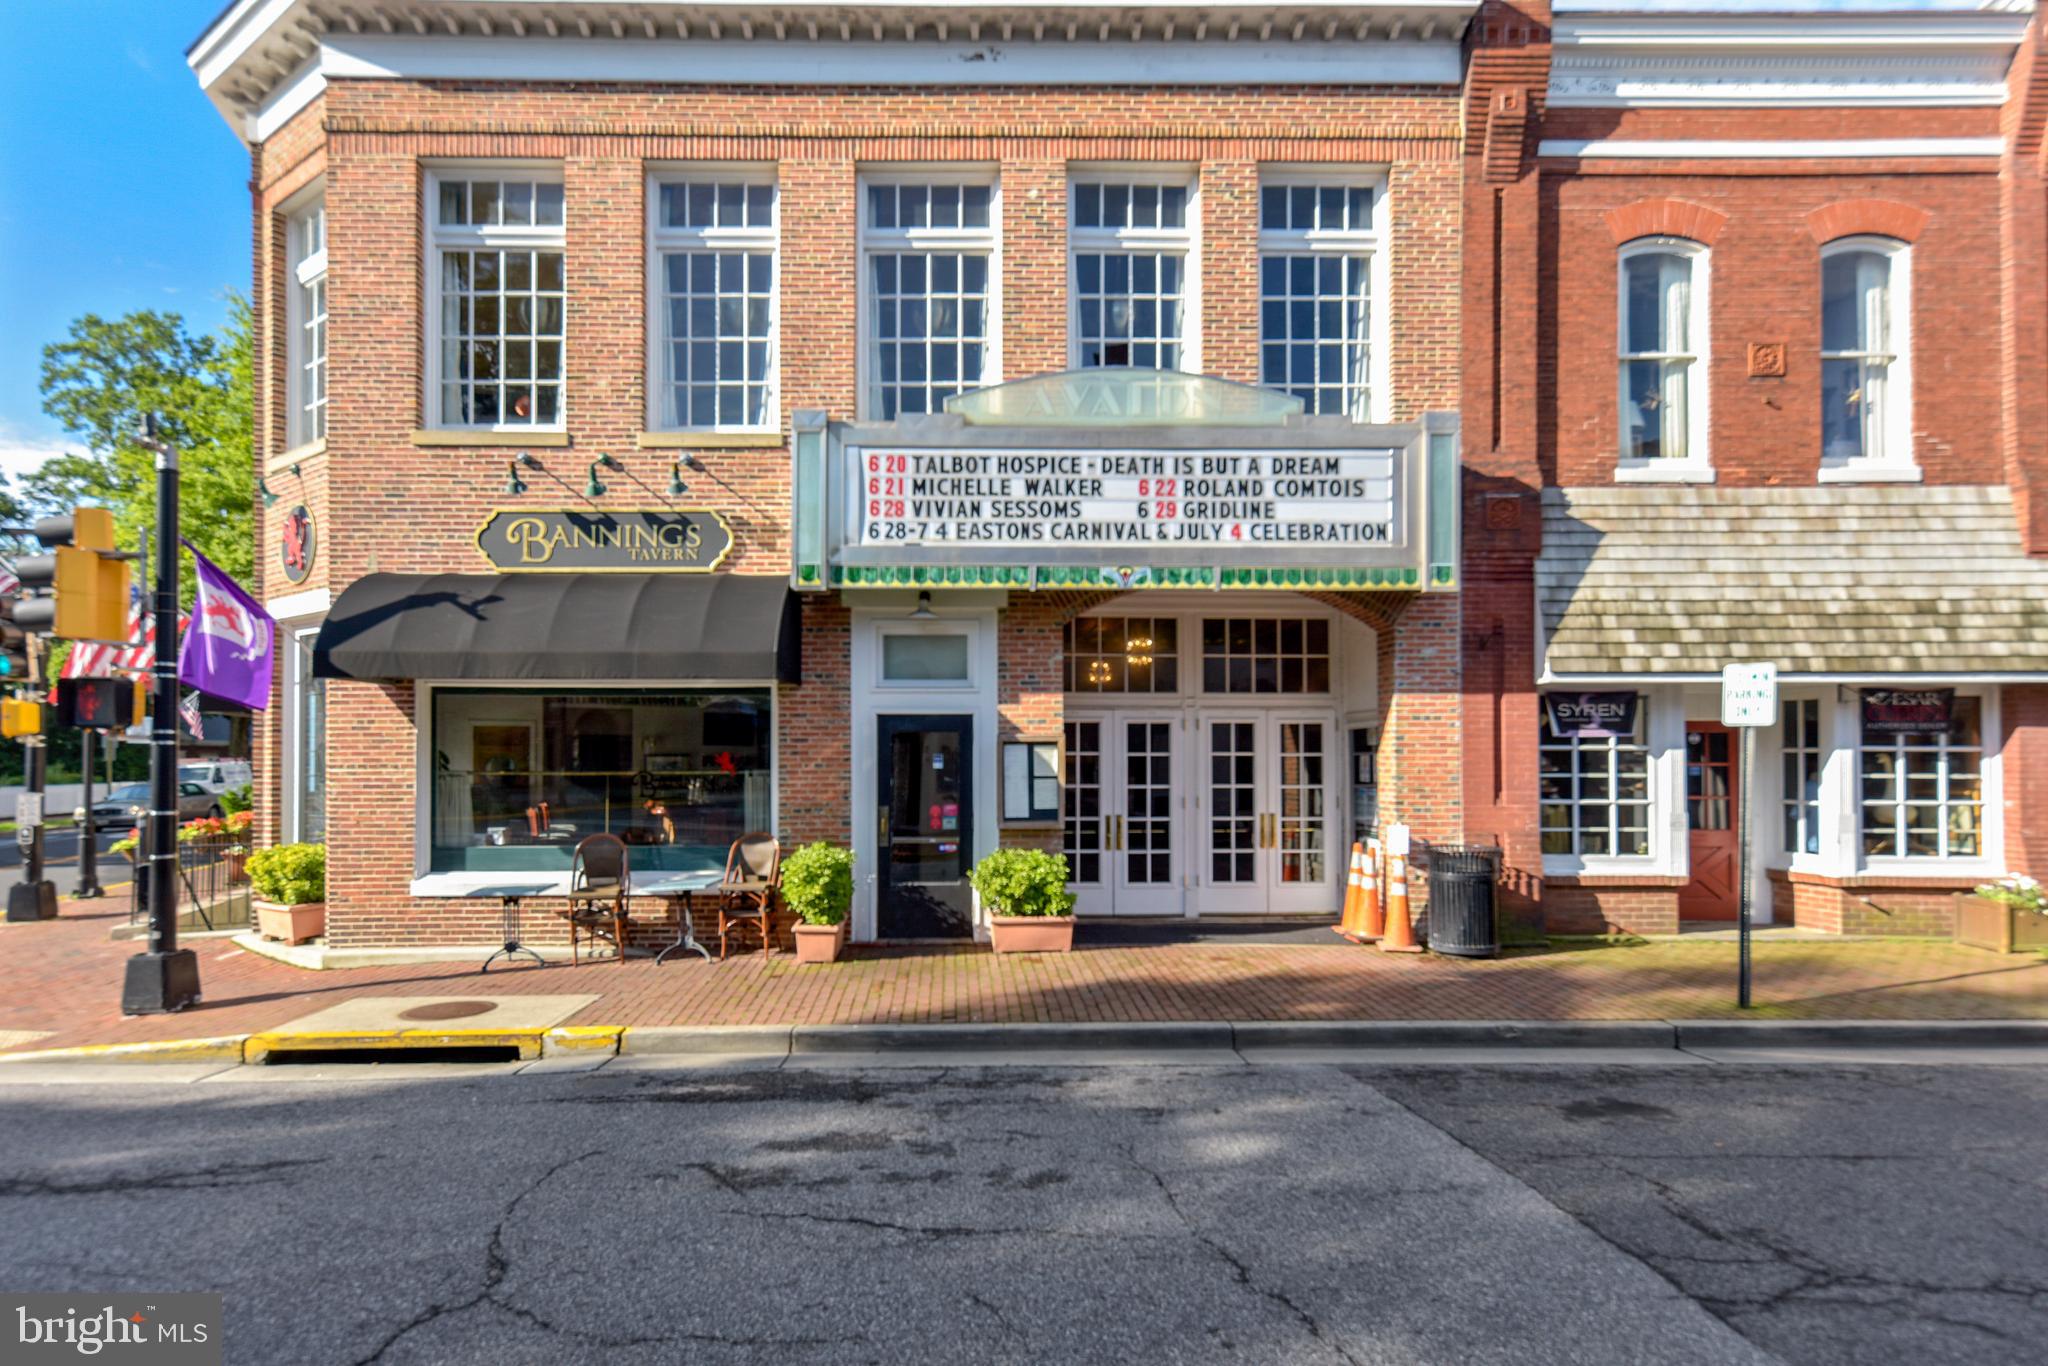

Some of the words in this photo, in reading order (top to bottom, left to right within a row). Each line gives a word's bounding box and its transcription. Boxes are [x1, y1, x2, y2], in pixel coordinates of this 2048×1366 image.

[912, 455, 991, 475] TALBOT
[997, 455, 1081, 475] HOSPICE
[1102, 455, 1164, 475] DEATH
[1173, 455, 1194, 475] IS
[1202, 455, 1241, 475] BUT
[1247, 455, 1261, 475] A
[1272, 455, 1340, 475] DREAM
[912, 477, 1011, 497] MICHELLE
[1024, 477, 1102, 497] WALKER
[1183, 478, 1264, 498] ROLAND
[1273, 478, 1364, 498] COMTOIS
[912, 499, 981, 519] VIVIAN
[991, 499, 1082, 519] SESSOMS
[1183, 500, 1275, 520] GRIDLINE
[506, 516, 702, 563] BANNINGS
[956, 521, 1043, 541] EASTONS
[1050, 521, 1152, 541] CARNIVAL
[1156, 521, 1169, 541] &
[1173, 521, 1223, 541] JULY
[1230, 521, 1242, 541] 4
[1250, 521, 1387, 541] CELEBRATION
[629, 548, 698, 561] TAVERN
[1557, 703, 1626, 717] SYREN
